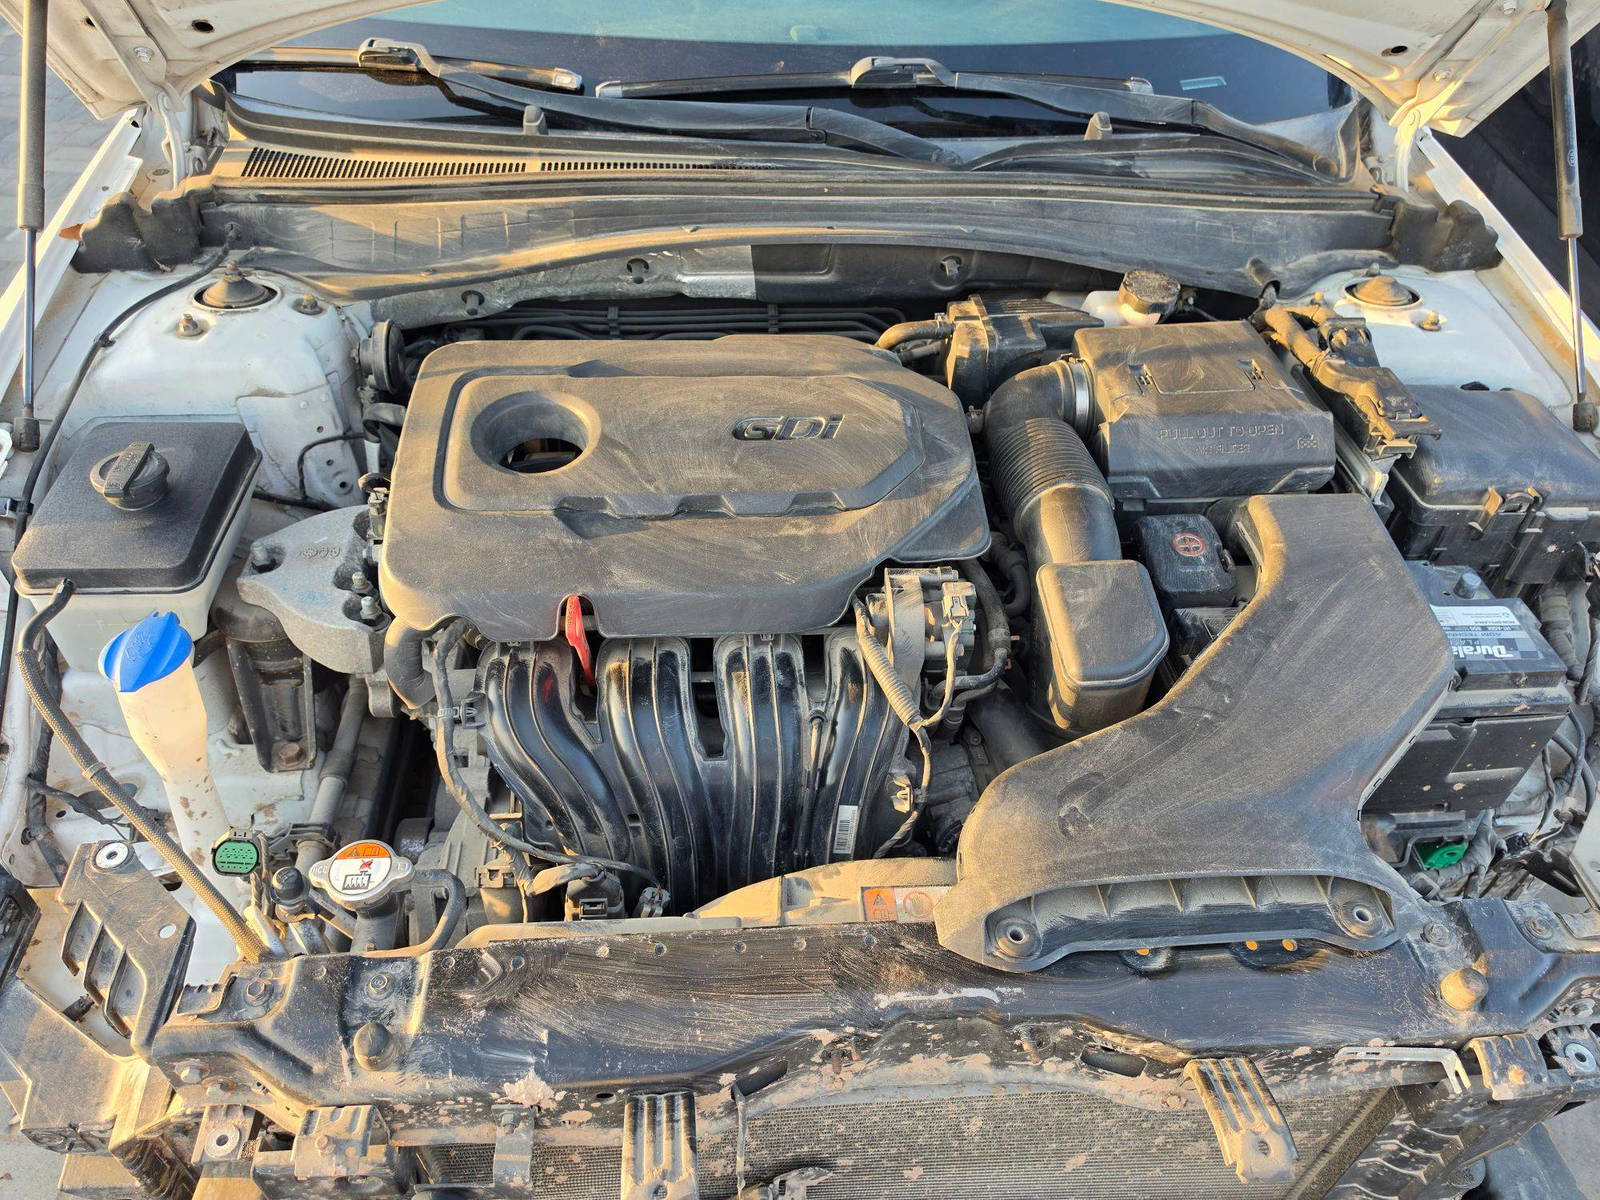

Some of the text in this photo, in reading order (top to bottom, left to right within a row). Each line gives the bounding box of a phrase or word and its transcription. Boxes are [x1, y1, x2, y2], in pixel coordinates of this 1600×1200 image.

[1160, 424, 1284, 440] PULL OUT TO OPEN
